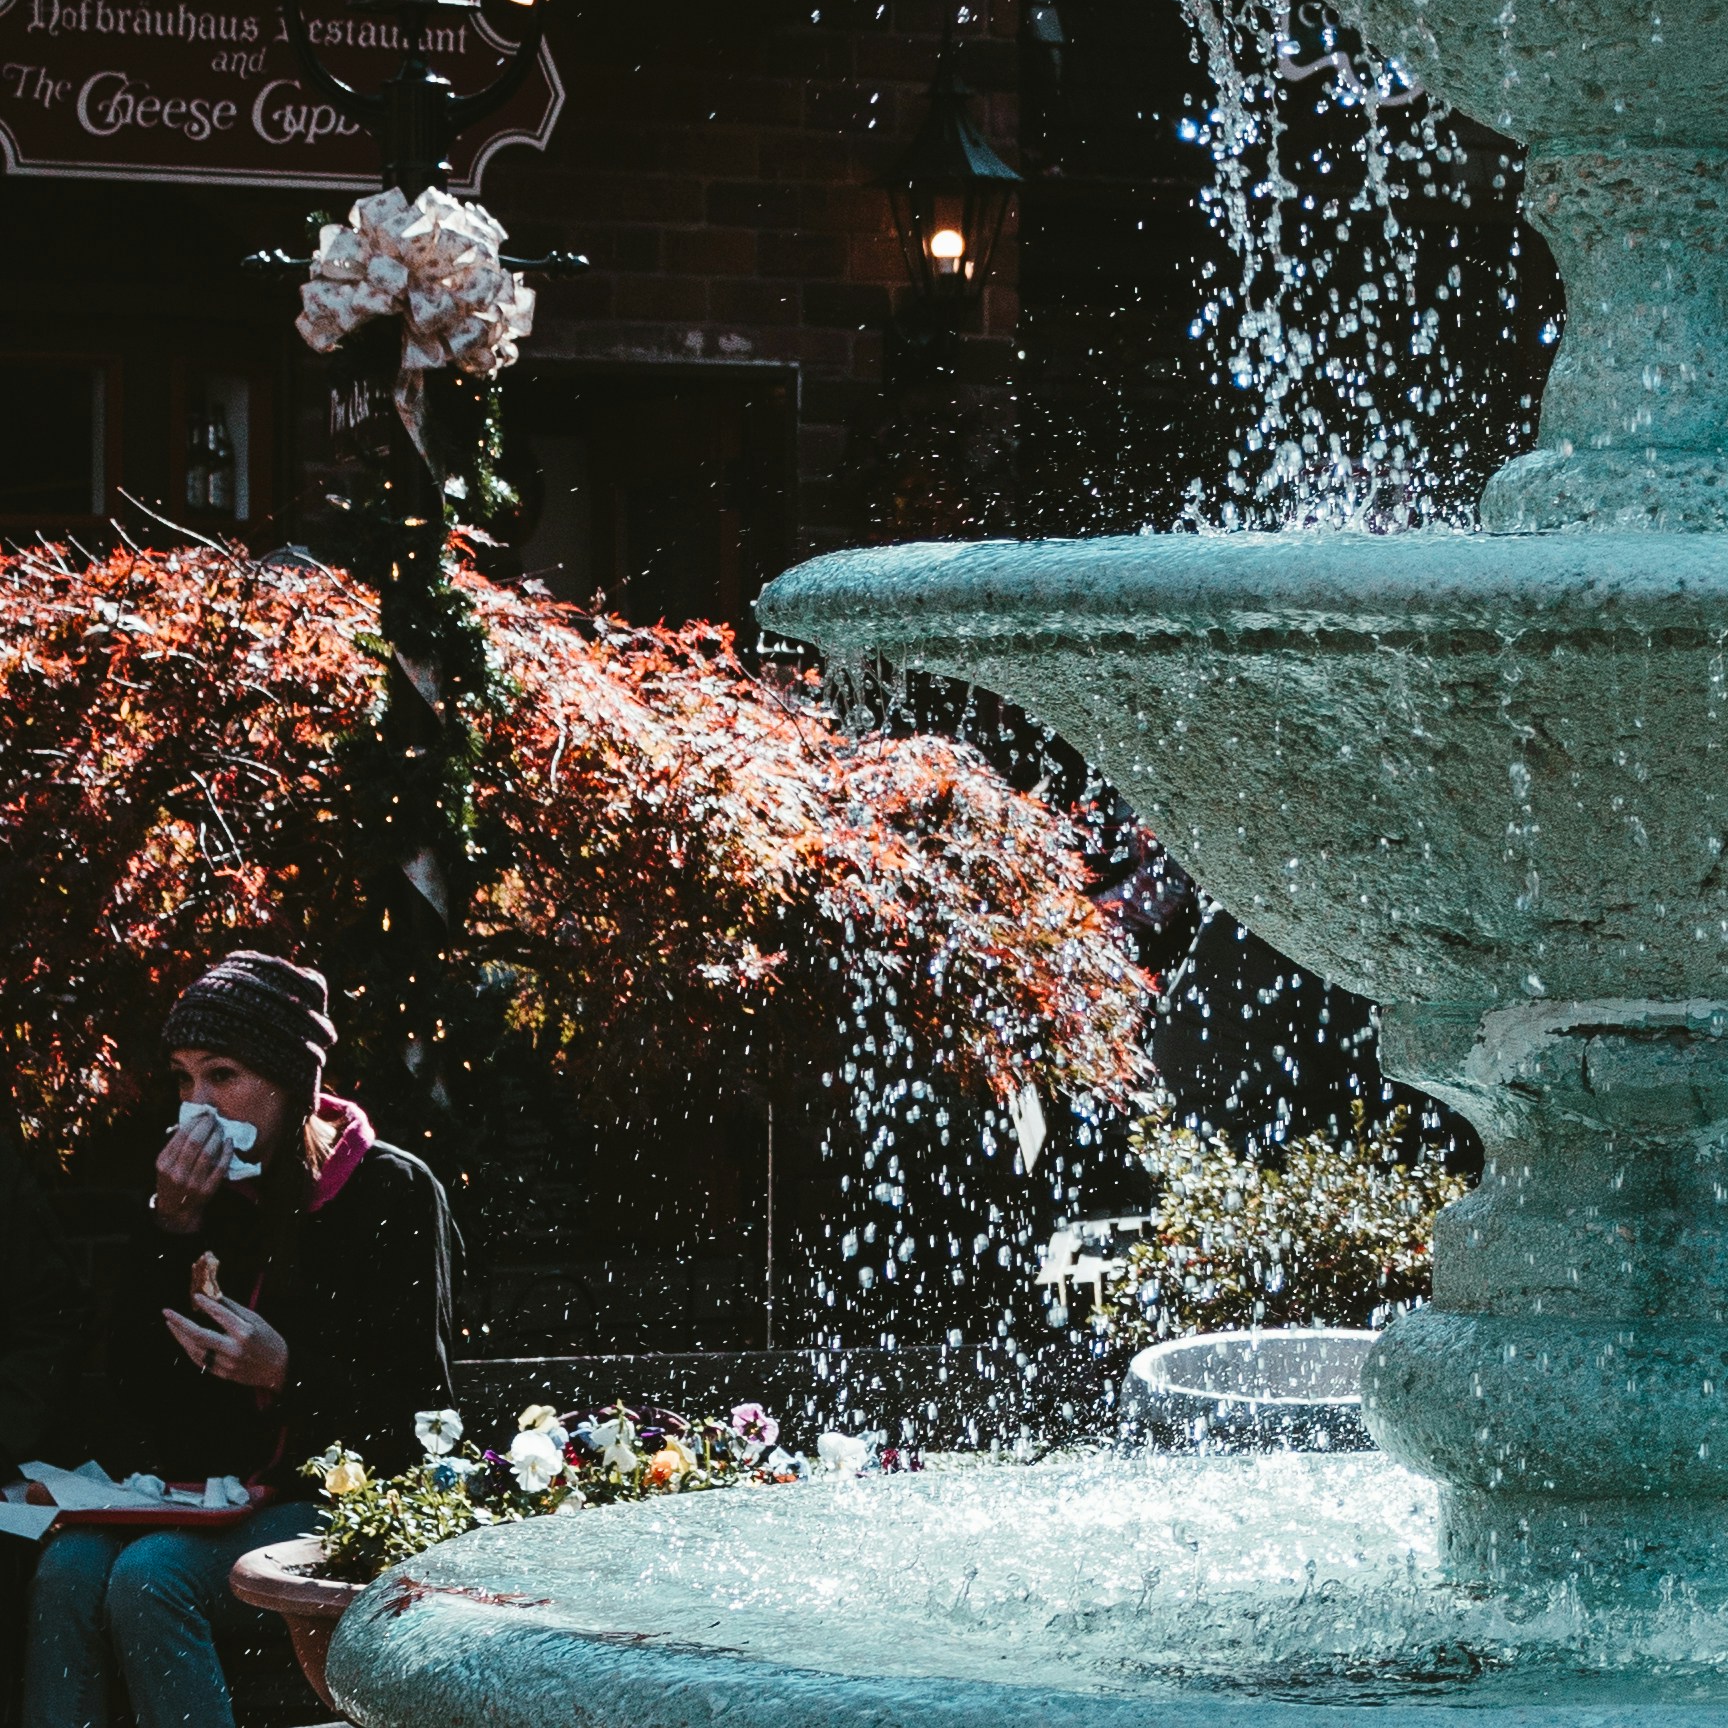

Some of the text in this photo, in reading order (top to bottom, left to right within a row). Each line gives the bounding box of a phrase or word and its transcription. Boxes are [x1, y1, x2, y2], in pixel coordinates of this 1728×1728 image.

[211, 46, 267, 80] and
[3, 62, 72, 109] The
[76, 70, 237, 142] Cheese
